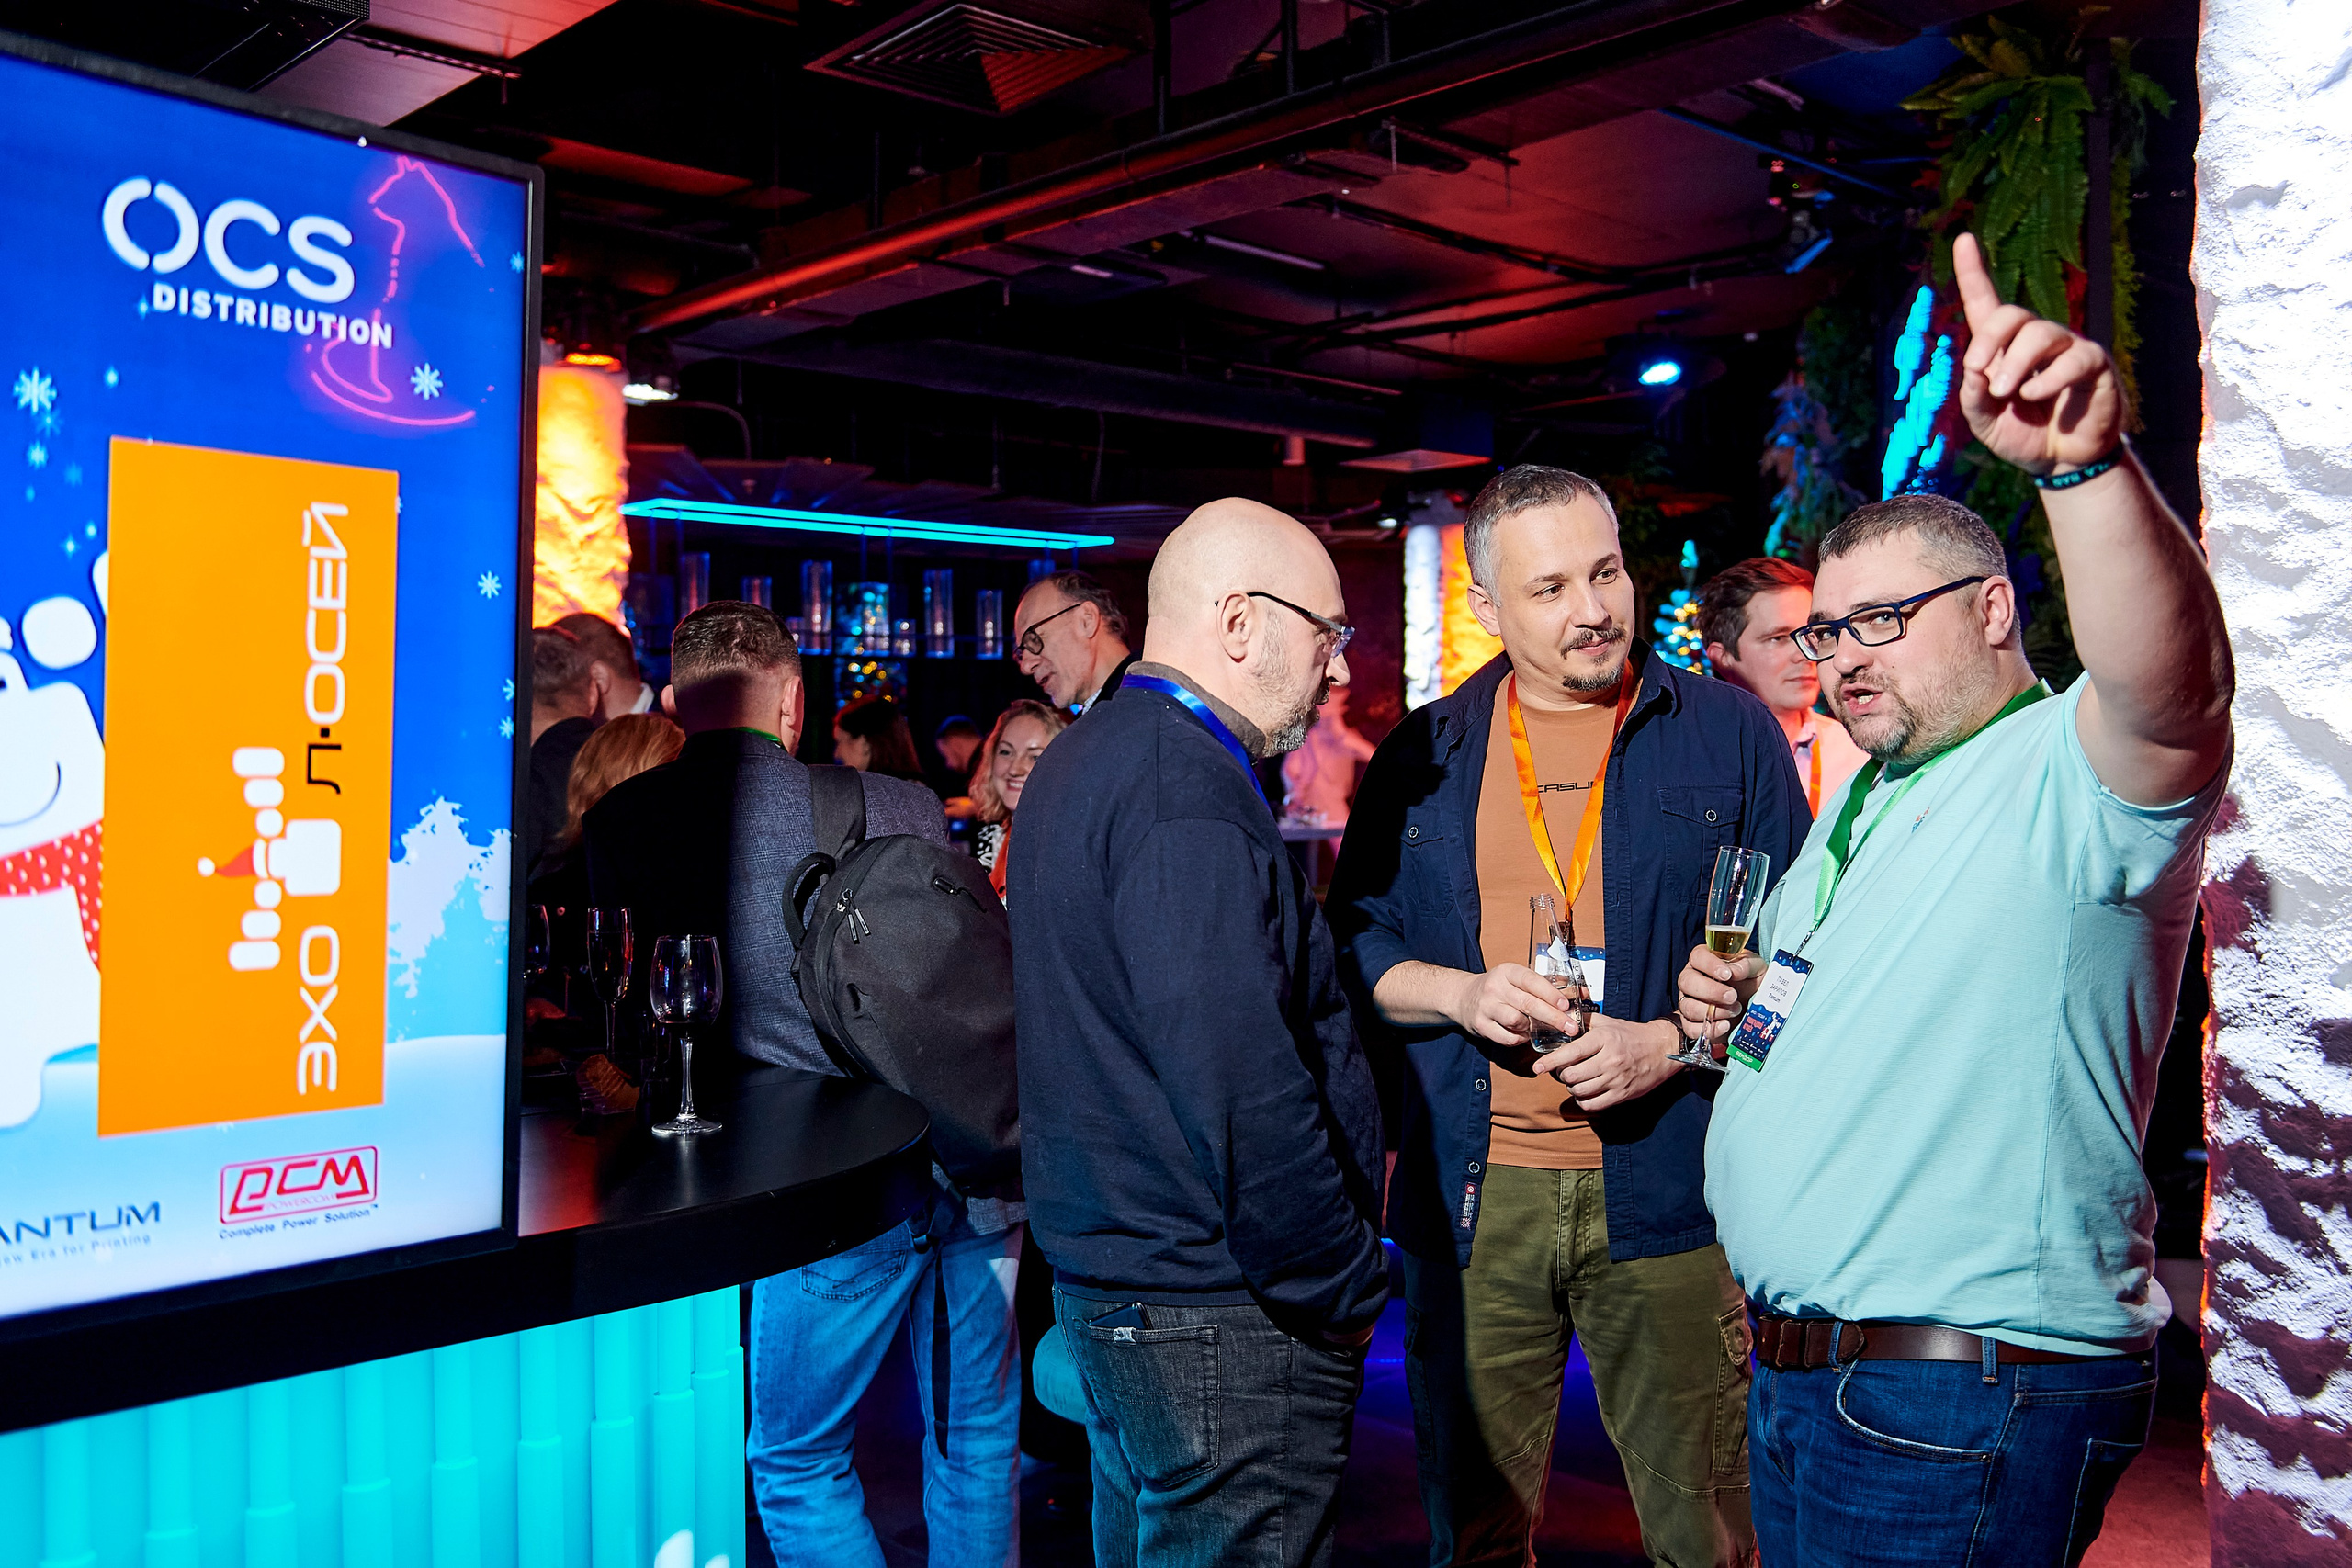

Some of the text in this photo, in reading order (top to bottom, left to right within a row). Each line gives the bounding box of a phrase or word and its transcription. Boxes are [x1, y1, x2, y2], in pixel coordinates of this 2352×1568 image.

[102, 176, 356, 303] OCS
[153, 282, 393, 349] DISTRIBUTION
[1537, 781, 1594, 793] ASU
[297, 925, 341, 1095] ЭХО
[219, 1224, 276, 1241] Complete
[282, 1217, 318, 1230] Power
[0, 1254, 23, 1268] ew
[63, 1245, 85, 1257] for
